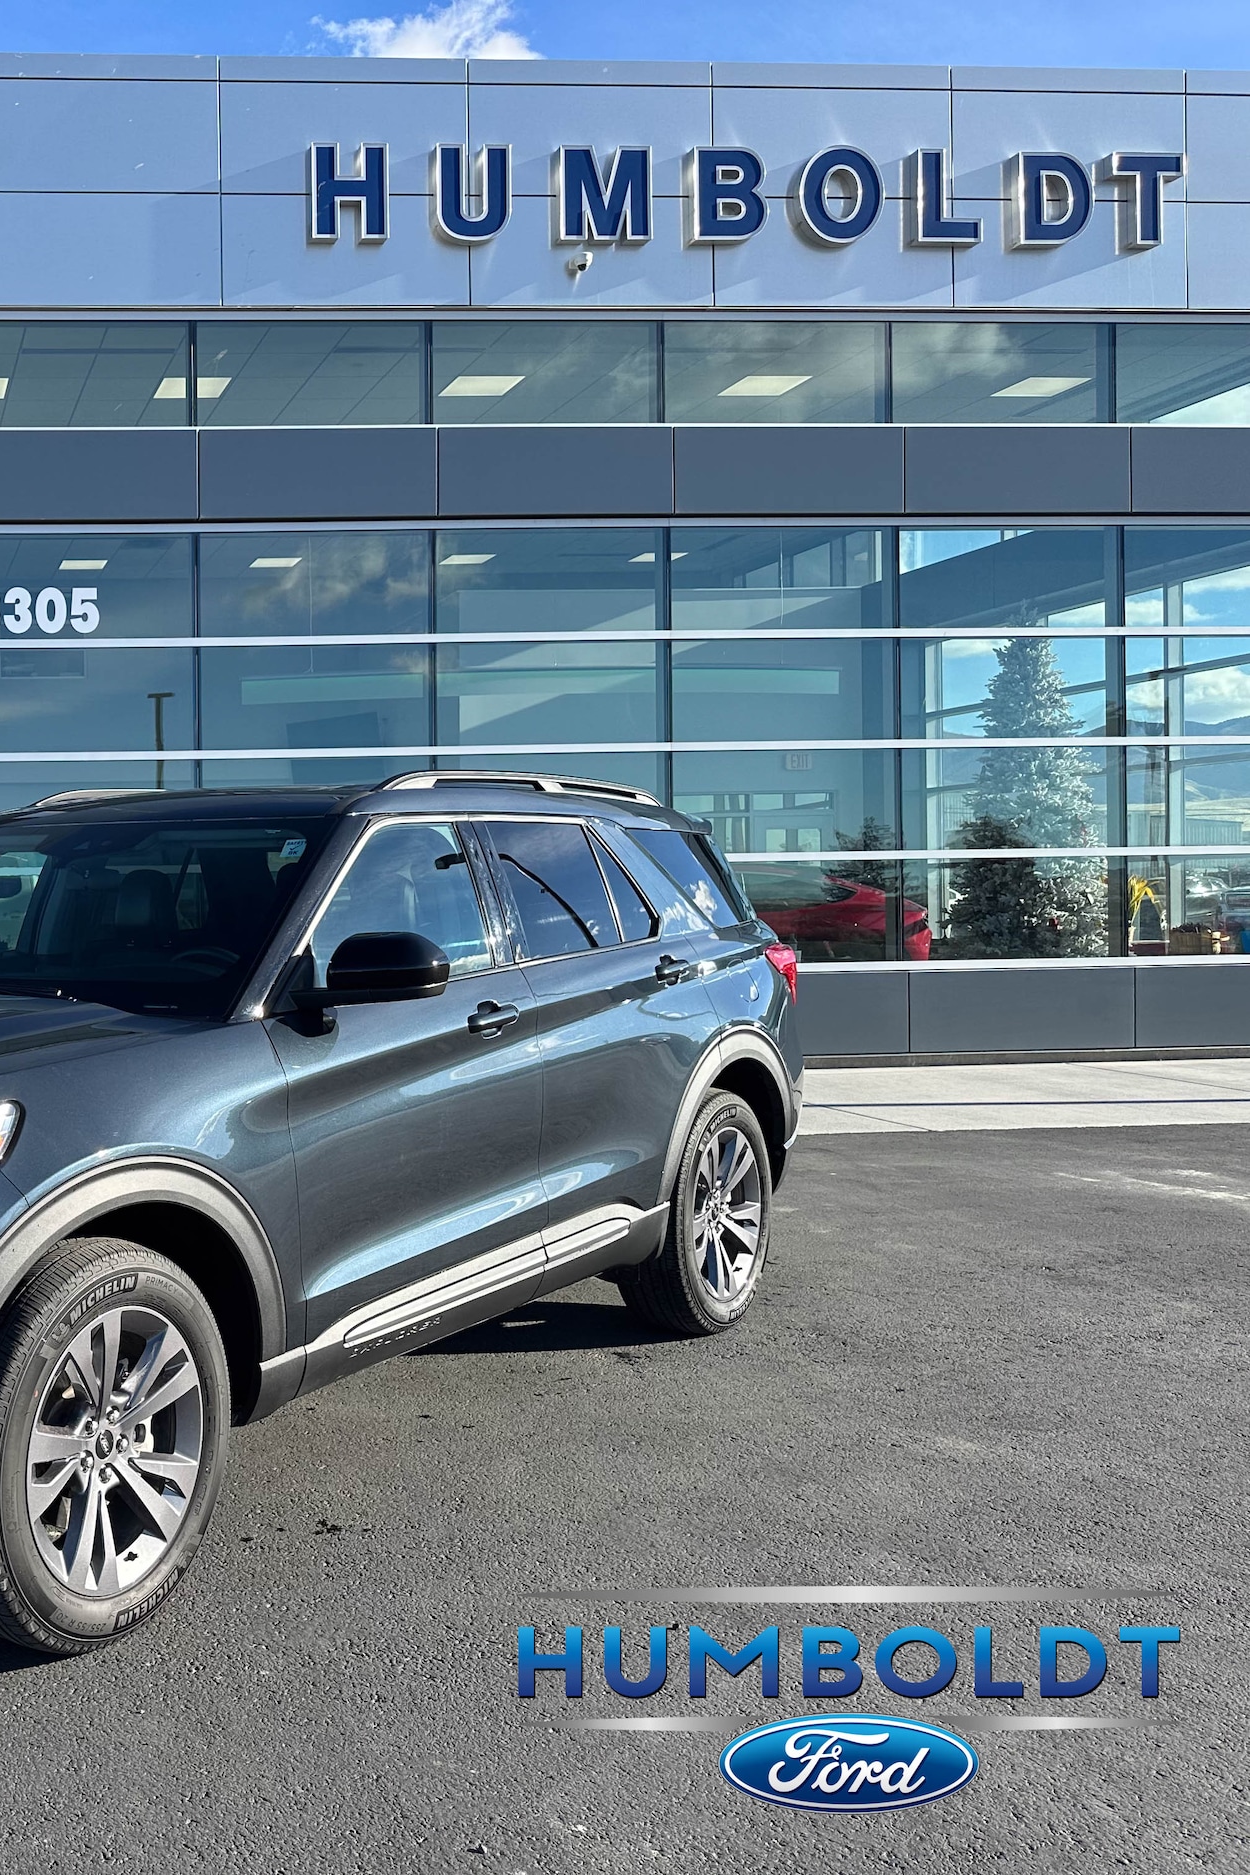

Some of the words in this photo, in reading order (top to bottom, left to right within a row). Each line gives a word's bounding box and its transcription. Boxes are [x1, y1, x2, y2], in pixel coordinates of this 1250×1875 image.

[307, 141, 1185, 250] HUMBOLDT
[790, 753, 810, 769] EXIT
[69, 1276, 136, 1325] MICHELIN
[144, 1275, 178, 1293] PRIMACY
[117, 1568, 179, 1628] MICHELIN
